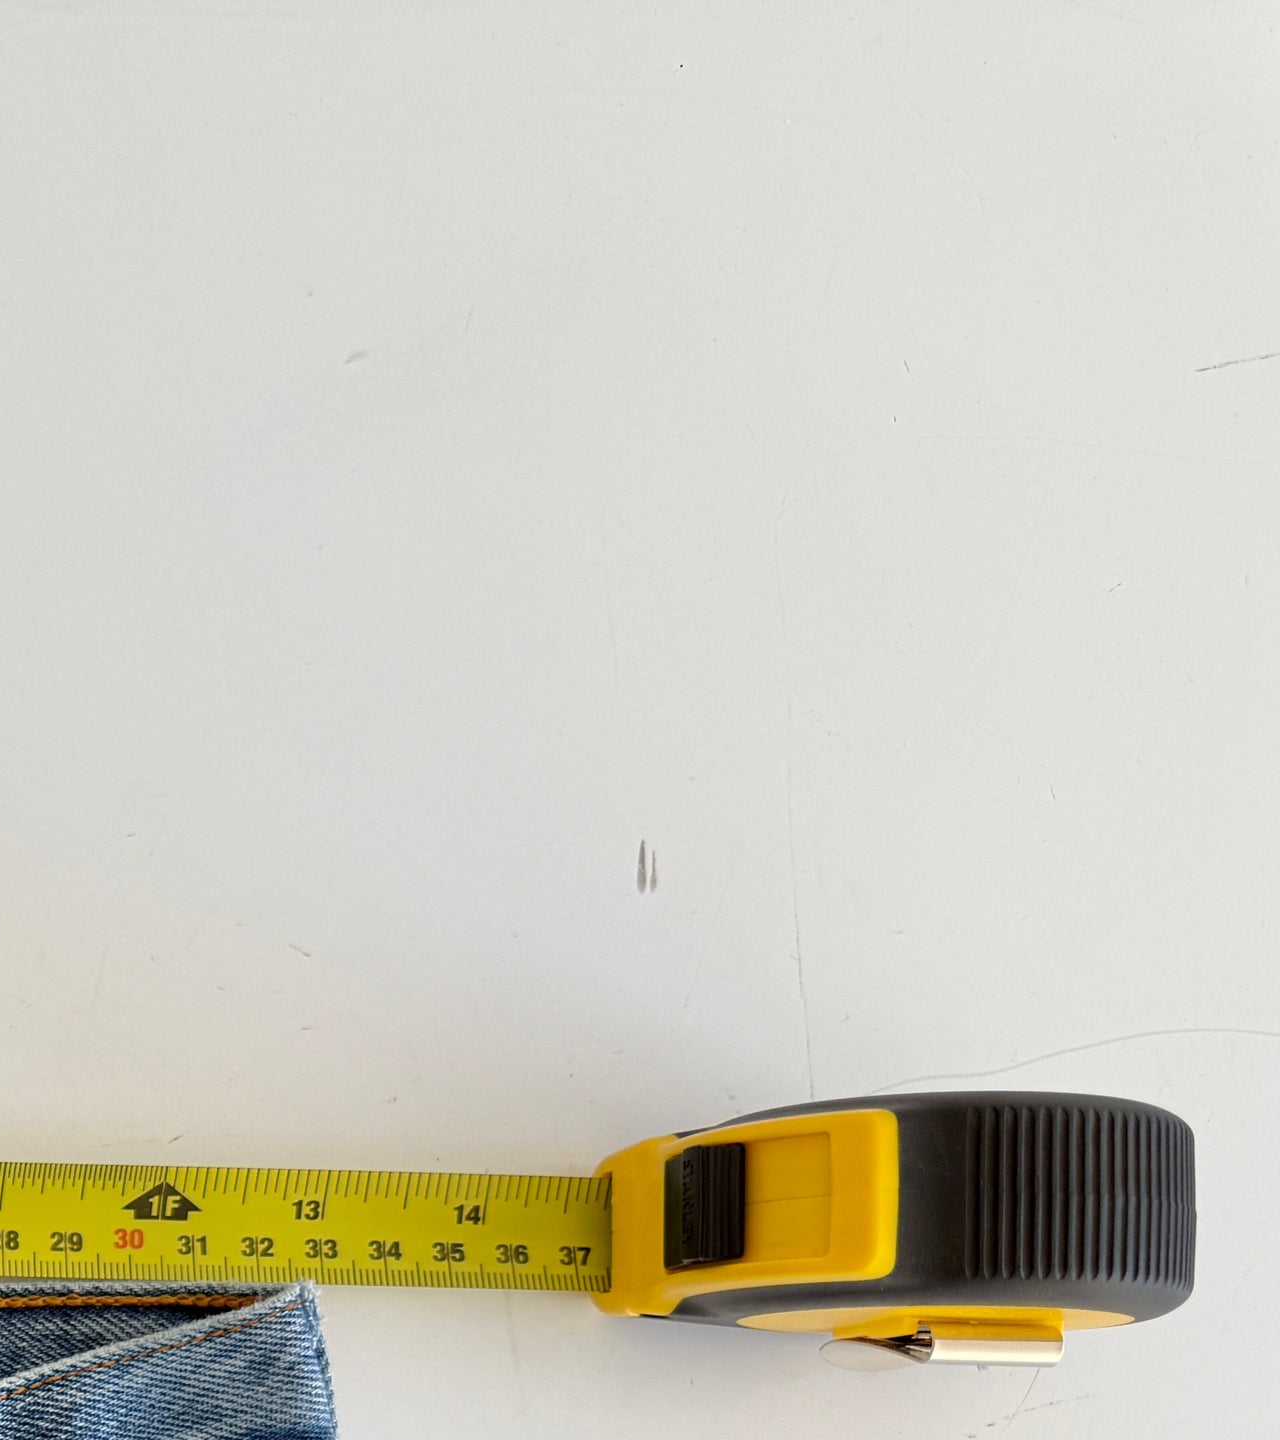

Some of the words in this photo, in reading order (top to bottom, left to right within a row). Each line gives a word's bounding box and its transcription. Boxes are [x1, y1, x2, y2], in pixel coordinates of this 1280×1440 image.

[149, 1195, 181, 1218] 1F
[292, 1200, 320, 1221] 13
[454, 1205, 481, 1225] 14
[682, 1160, 694, 1247] STANLEY
[50, 1232, 83, 1252] 29
[113, 1229, 144, 1250] 30
[177, 1235, 207, 1256] 31
[241, 1237, 274, 1258] 32
[305, 1239, 338, 1260] 33
[369, 1241, 402, 1261] 34
[432, 1243, 465, 1263] 35
[496, 1244, 528, 1265] 36
[559, 1246, 591, 1267] 37
